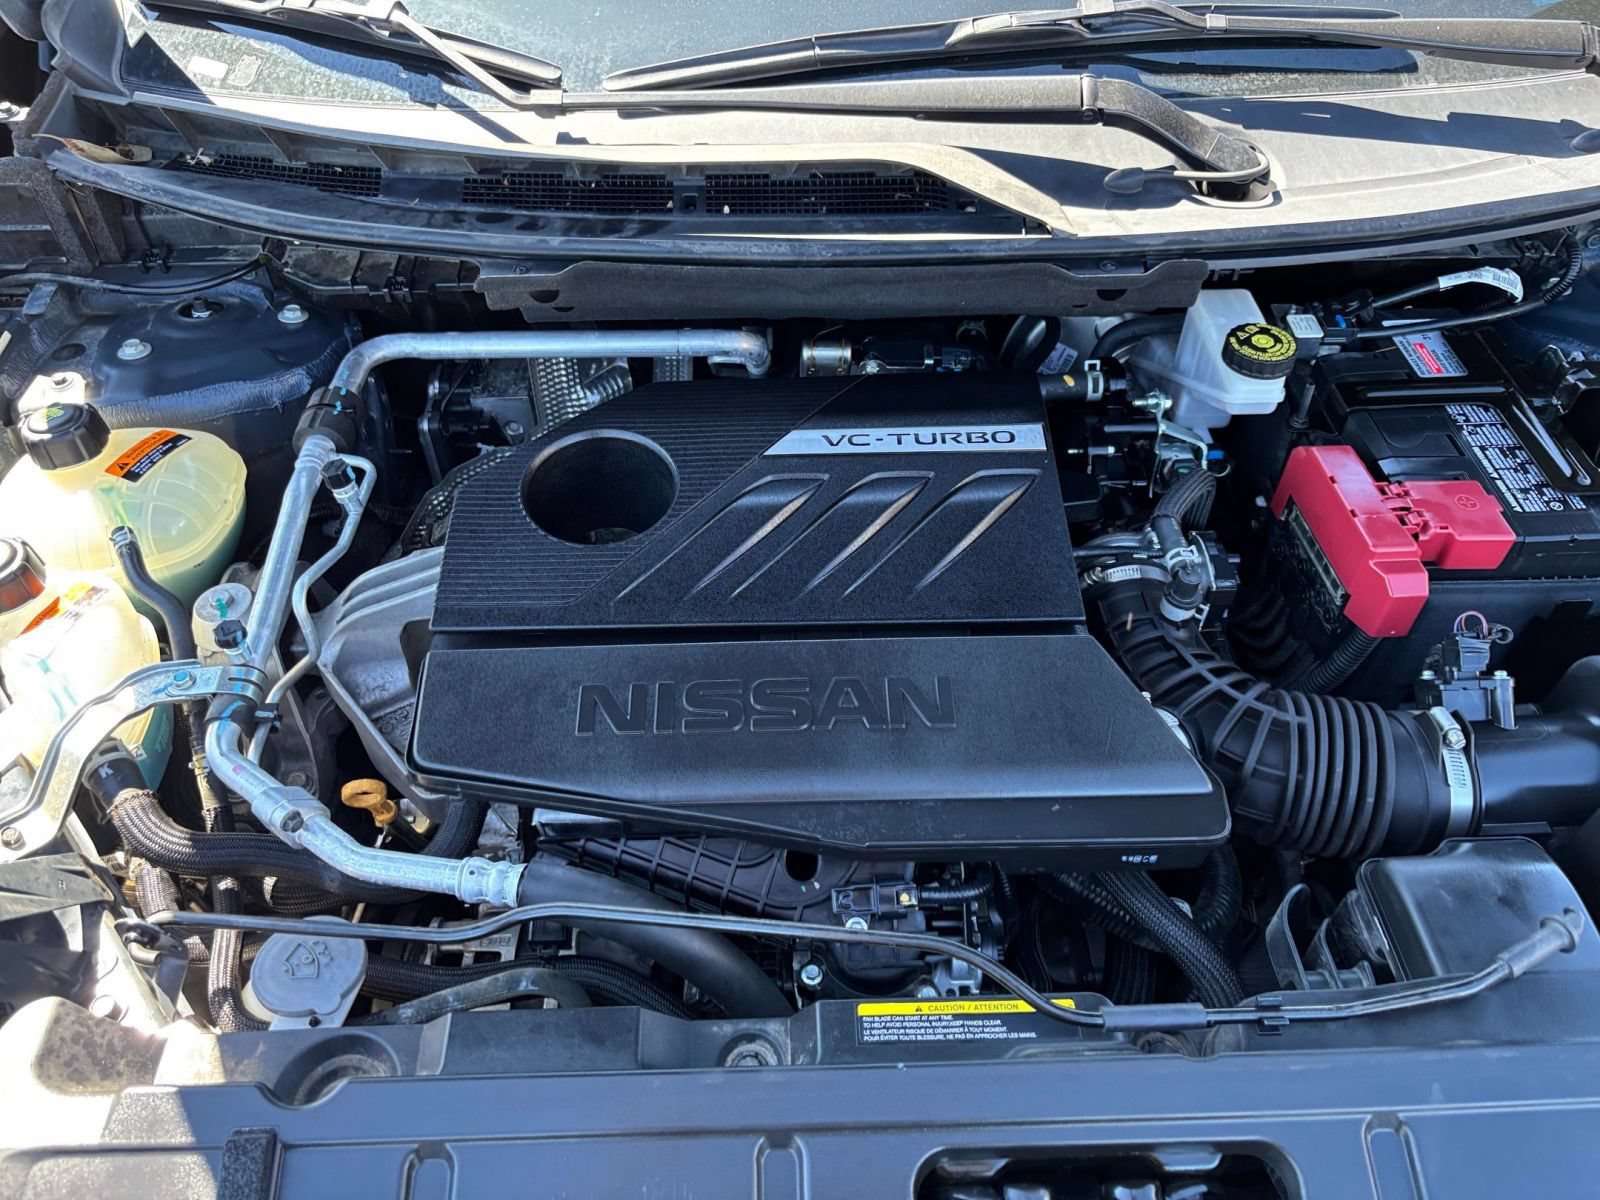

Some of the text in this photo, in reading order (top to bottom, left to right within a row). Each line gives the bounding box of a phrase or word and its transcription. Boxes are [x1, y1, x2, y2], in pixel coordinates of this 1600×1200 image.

[822, 430, 1016, 447] VC-TURBO
[575, 676, 957, 736] NISSAN
[928, 1003, 965, 1012] CAUTION
[974, 1002, 1019, 1011] ATTENTION
